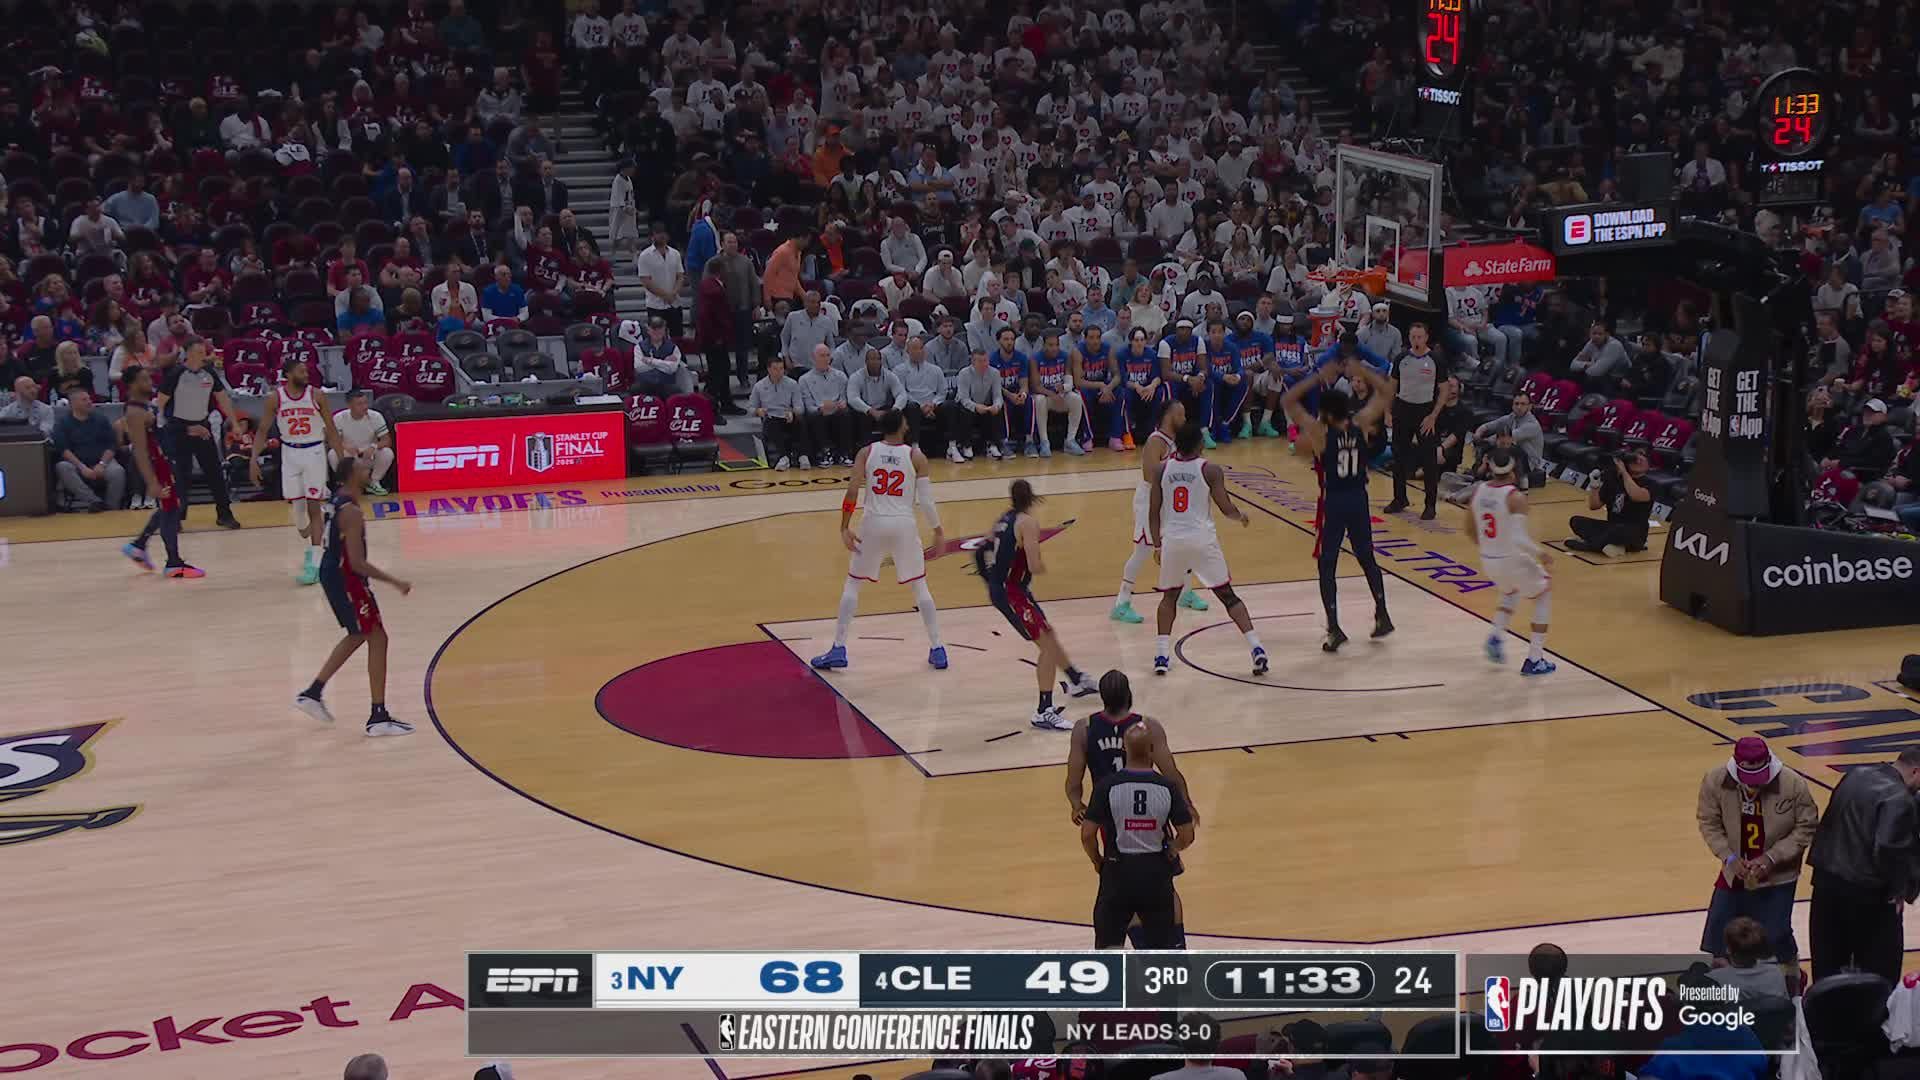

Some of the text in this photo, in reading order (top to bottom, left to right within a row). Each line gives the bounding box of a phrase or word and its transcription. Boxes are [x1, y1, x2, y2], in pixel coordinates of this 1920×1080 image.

[1426, 12, 1459, 64] 24
[1775, 93, 1820, 115] 11:33
[1774, 117, 1811, 144] 24
[1778, 160, 1824, 173] TISSOT
[1594, 208, 1655, 227] DOWNLOAD
[1594, 221, 1667, 243] THE ESPN APP
[369, 370, 402, 385] CLE
[415, 371, 448, 385] CLE
[1707, 367, 1722, 389] GET
[1736, 370, 1760, 391] GET
[1706, 388, 1720, 411] THE
[1736, 394, 1758, 413] THE
[628, 405, 660, 421] CLE
[288, 418, 311, 435] 25
[555, 431, 608, 442] STANLEY CUP
[668, 418, 702, 433] CLE
[1741, 413, 1763, 440] App
[414, 445, 500, 471] ESPN
[555, 440, 604, 456] FINAL
[872, 469, 905, 496] 32
[371, 489, 588, 519] PLAYOFFS
[600, 484, 695, 499] Presented
[697, 482, 721, 493] by
[1174, 487, 1188, 512] 8
[1483, 513, 1496, 538] 3
[1674, 526, 1729, 566] KIA
[1762, 552, 1913, 588] coinbase
[1133, 790, 1147, 815] 8
[1746, 822, 1760, 849] 2
